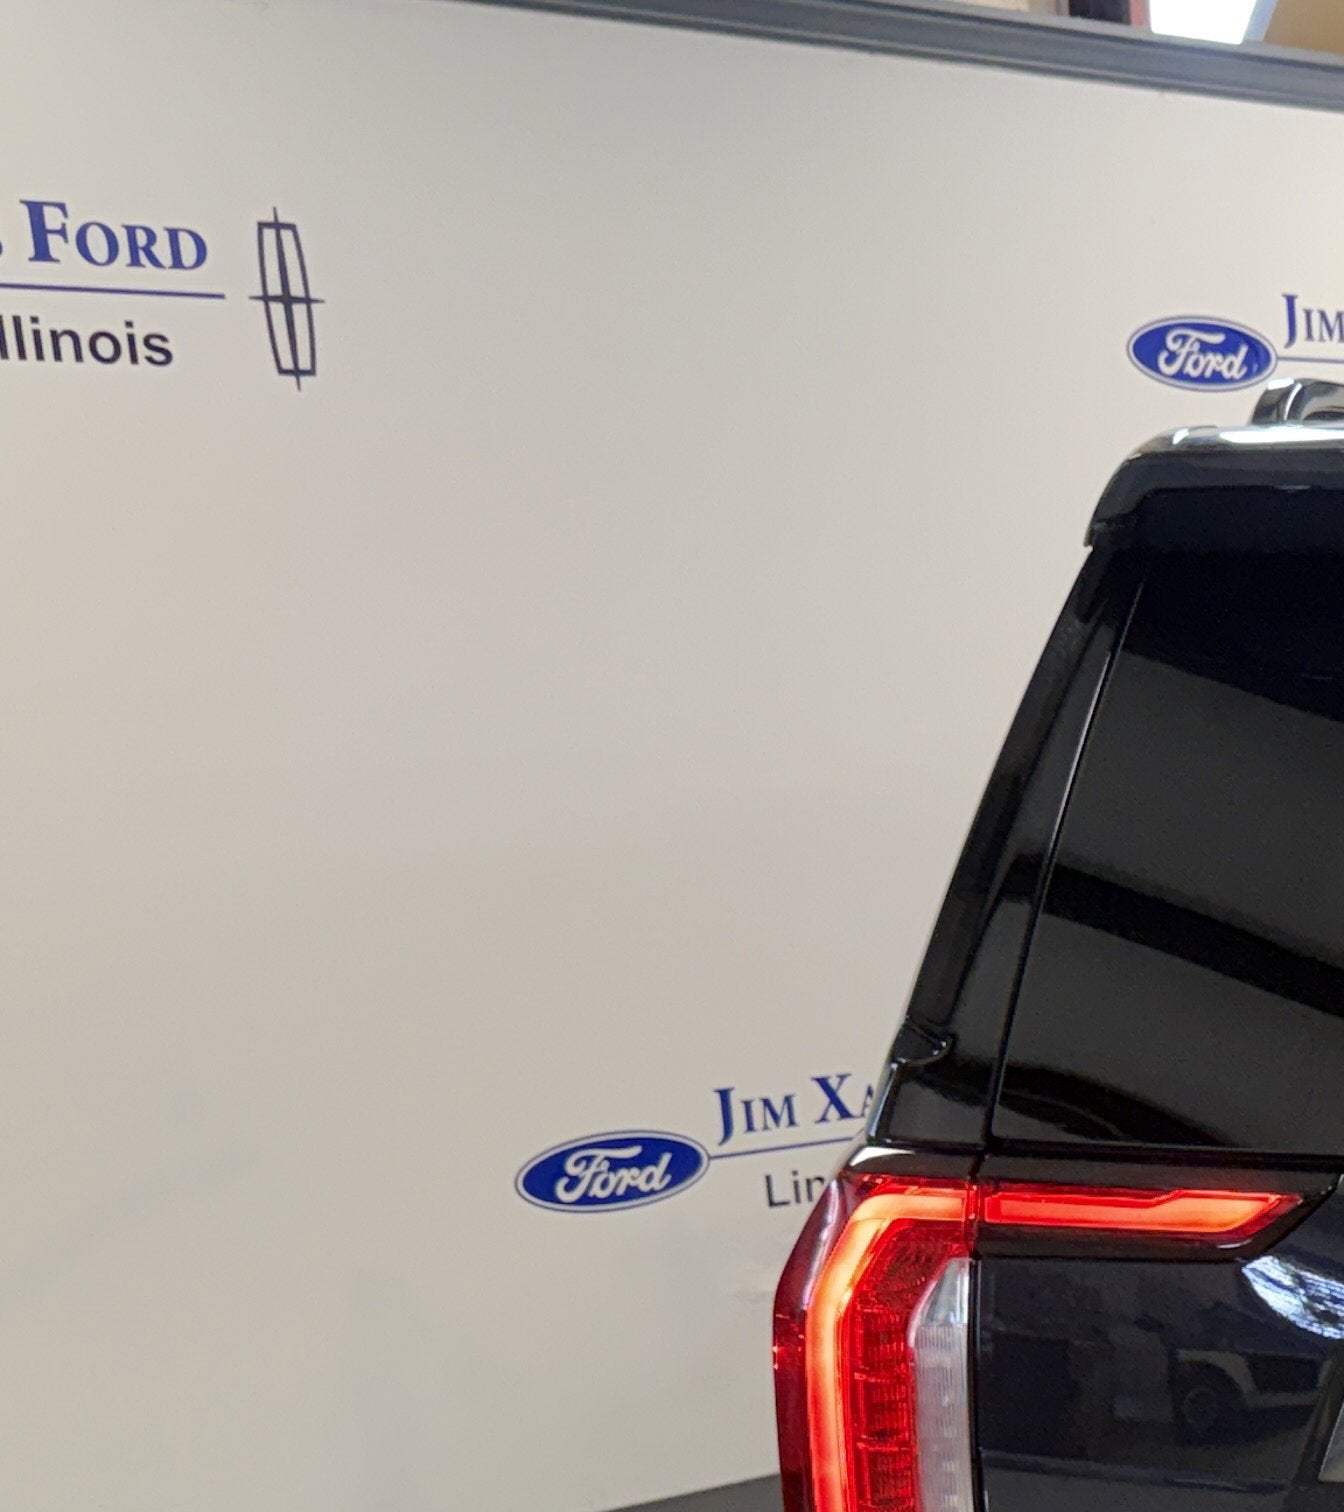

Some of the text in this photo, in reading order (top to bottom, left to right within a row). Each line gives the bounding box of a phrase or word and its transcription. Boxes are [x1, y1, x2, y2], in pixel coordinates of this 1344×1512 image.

[19, 199, 208, 270] FORD
[1157, 326, 1248, 379] Ford
[713, 1086, 799, 1147] JIM
[554, 1145, 672, 1203] Ford
